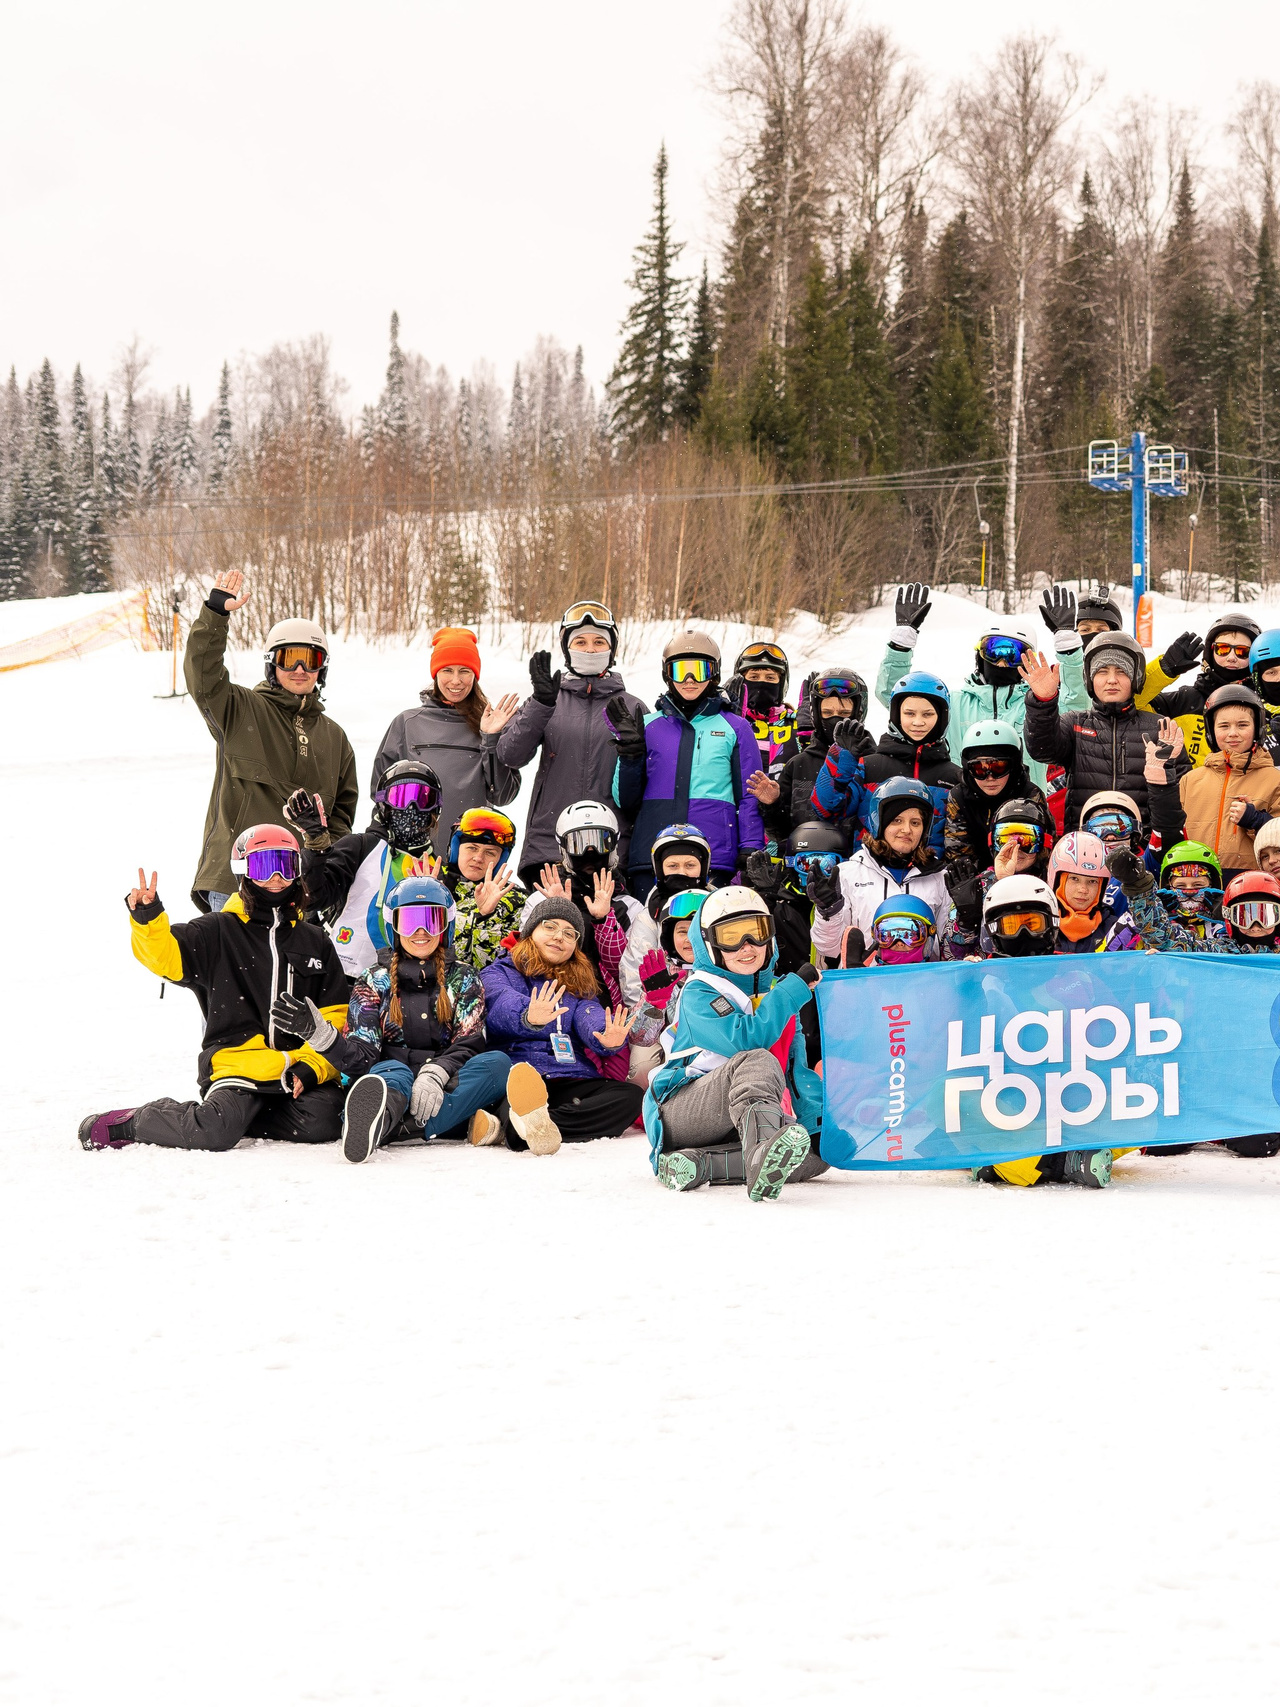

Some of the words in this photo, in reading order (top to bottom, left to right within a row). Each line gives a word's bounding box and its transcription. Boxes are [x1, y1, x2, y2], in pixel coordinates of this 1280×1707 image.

[882, 1004, 911, 1162] pluscamp.ru
[947, 1002, 1183, 1080] царь
[944, 1062, 1180, 1147] горы
